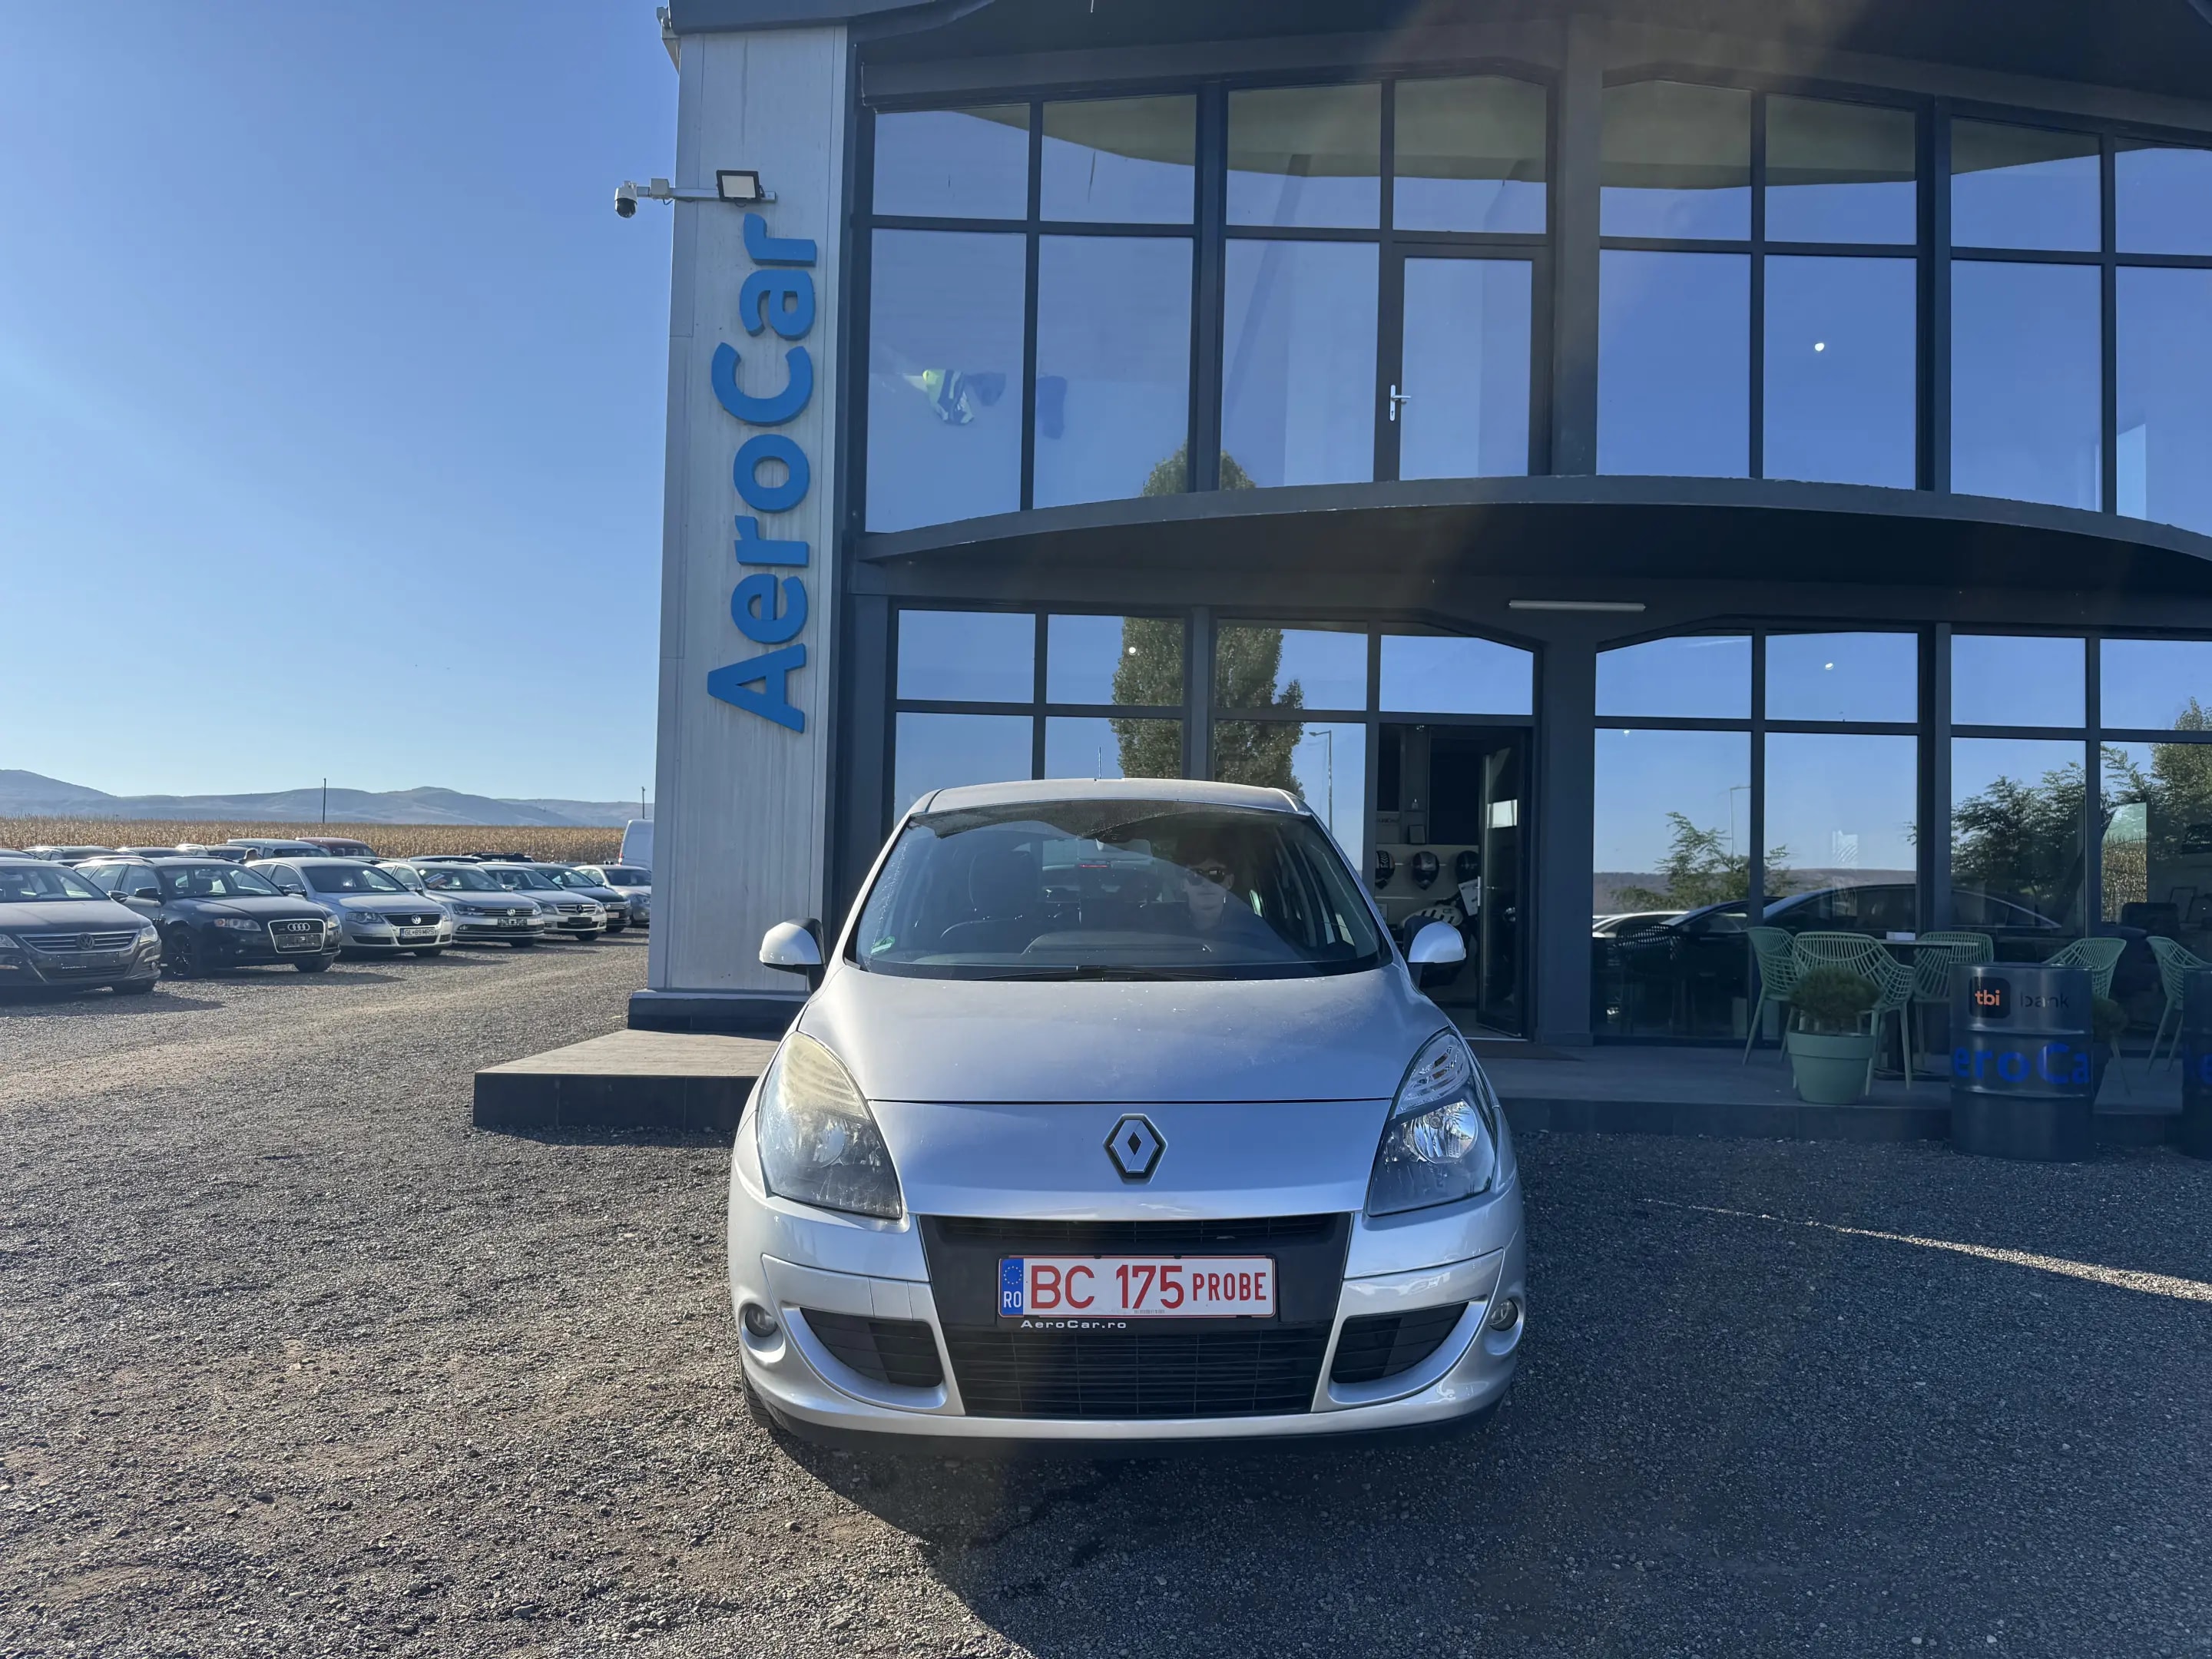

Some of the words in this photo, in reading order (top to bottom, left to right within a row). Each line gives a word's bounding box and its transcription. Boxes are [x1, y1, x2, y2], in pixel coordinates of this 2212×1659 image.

[707, 213, 818, 734] AeroCar
[1975, 989, 2001, 1006] tbi
[2020, 992, 2069, 1008] bank
[1003, 1291, 1022, 1308] RO
[1031, 1265, 1094, 1309] BC
[1116, 1264, 1184, 1309] 175
[1193, 1272, 1267, 1301] PROBE
[1021, 1320, 1127, 1329] AeroCar.ro
